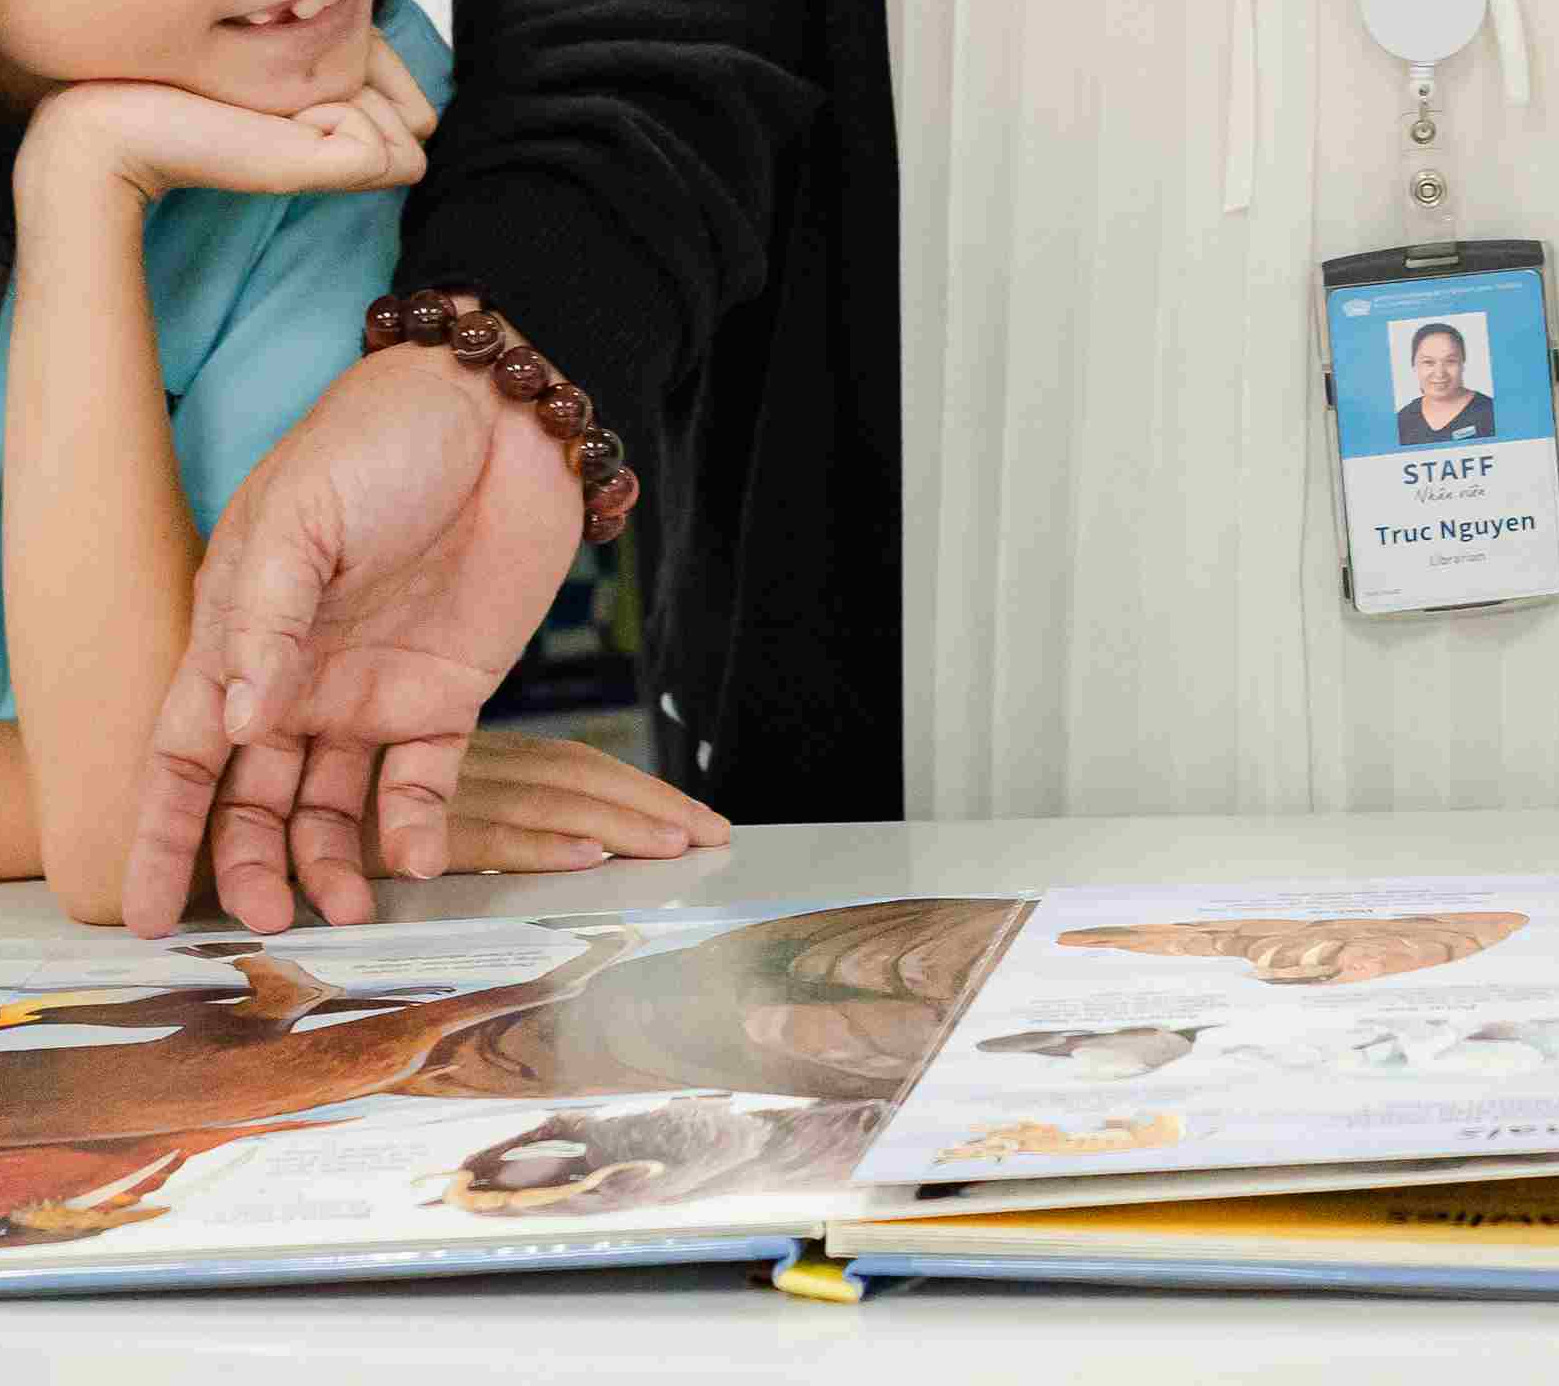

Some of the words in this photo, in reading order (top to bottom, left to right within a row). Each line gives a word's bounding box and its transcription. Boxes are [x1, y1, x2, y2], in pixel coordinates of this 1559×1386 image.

[1403, 455, 1494, 485] STAFF
[1375, 525, 1432, 546] Truc
[1440, 514, 1536, 543] Nguyen
